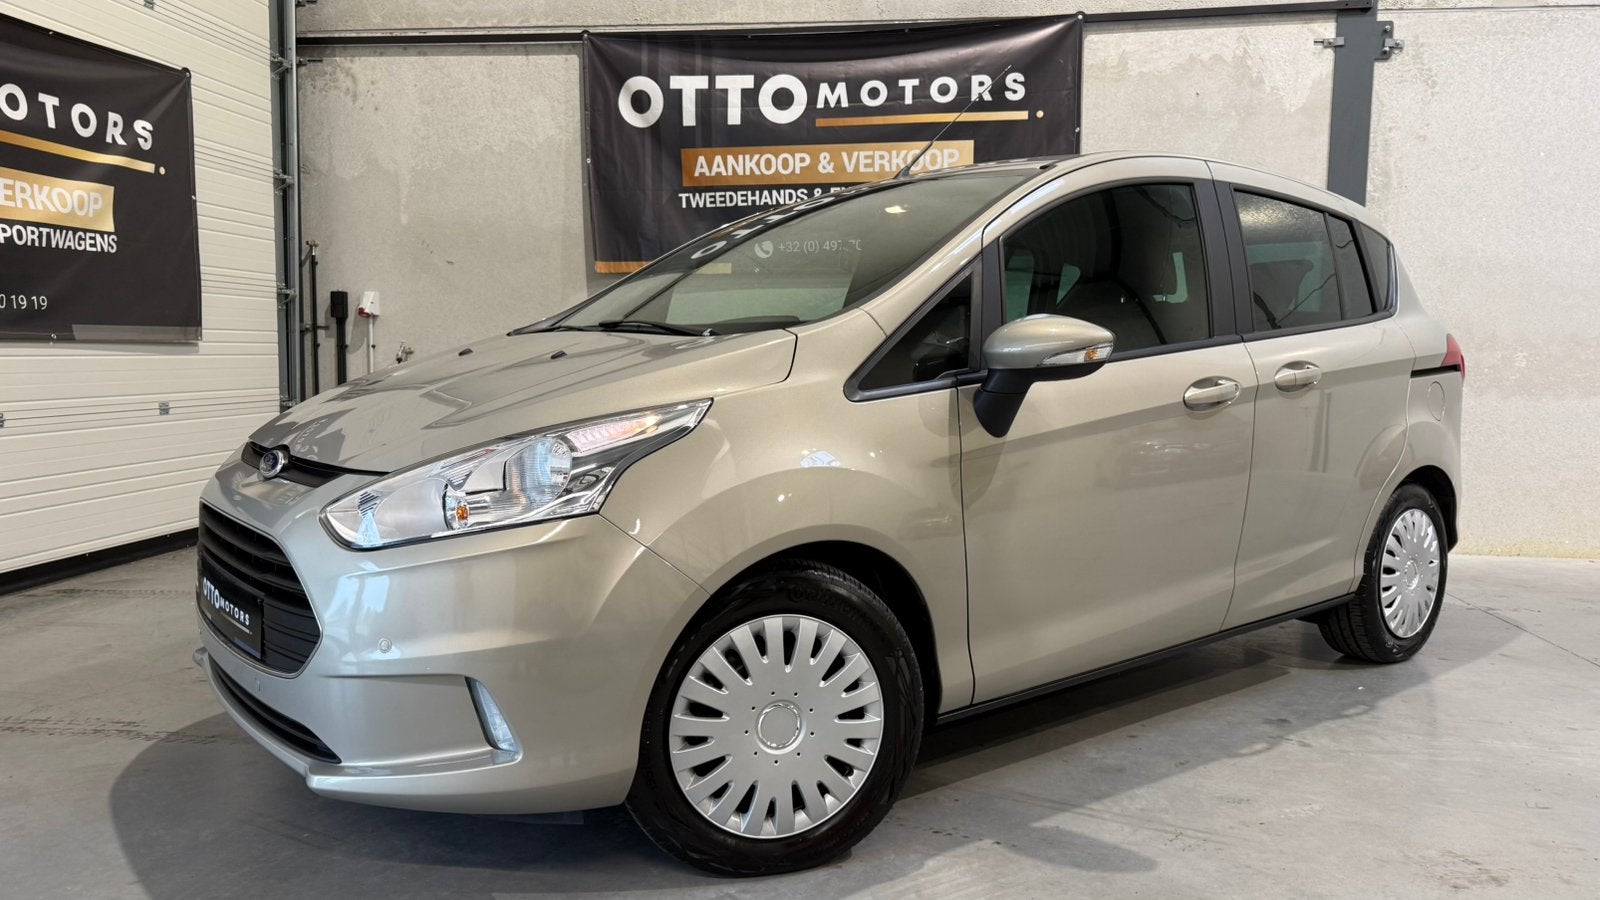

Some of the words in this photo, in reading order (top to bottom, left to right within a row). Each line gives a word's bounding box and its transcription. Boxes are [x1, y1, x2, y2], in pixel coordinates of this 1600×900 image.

[694, 152, 811, 177] AANKOOP
[817, 151, 835, 174] &
[842, 148, 960, 173] VERKOOP
[0, 177, 103, 218] ERKOOP
[678, 188, 808, 208] TWEEDEHANDS
[0, 223, 118, 253] PORTWAGENS
[778, 240, 800, 253] +32
[803, 239, 820, 254] (0)
[10, 295, 27, 310] 19
[31, 296, 48, 310] 19
